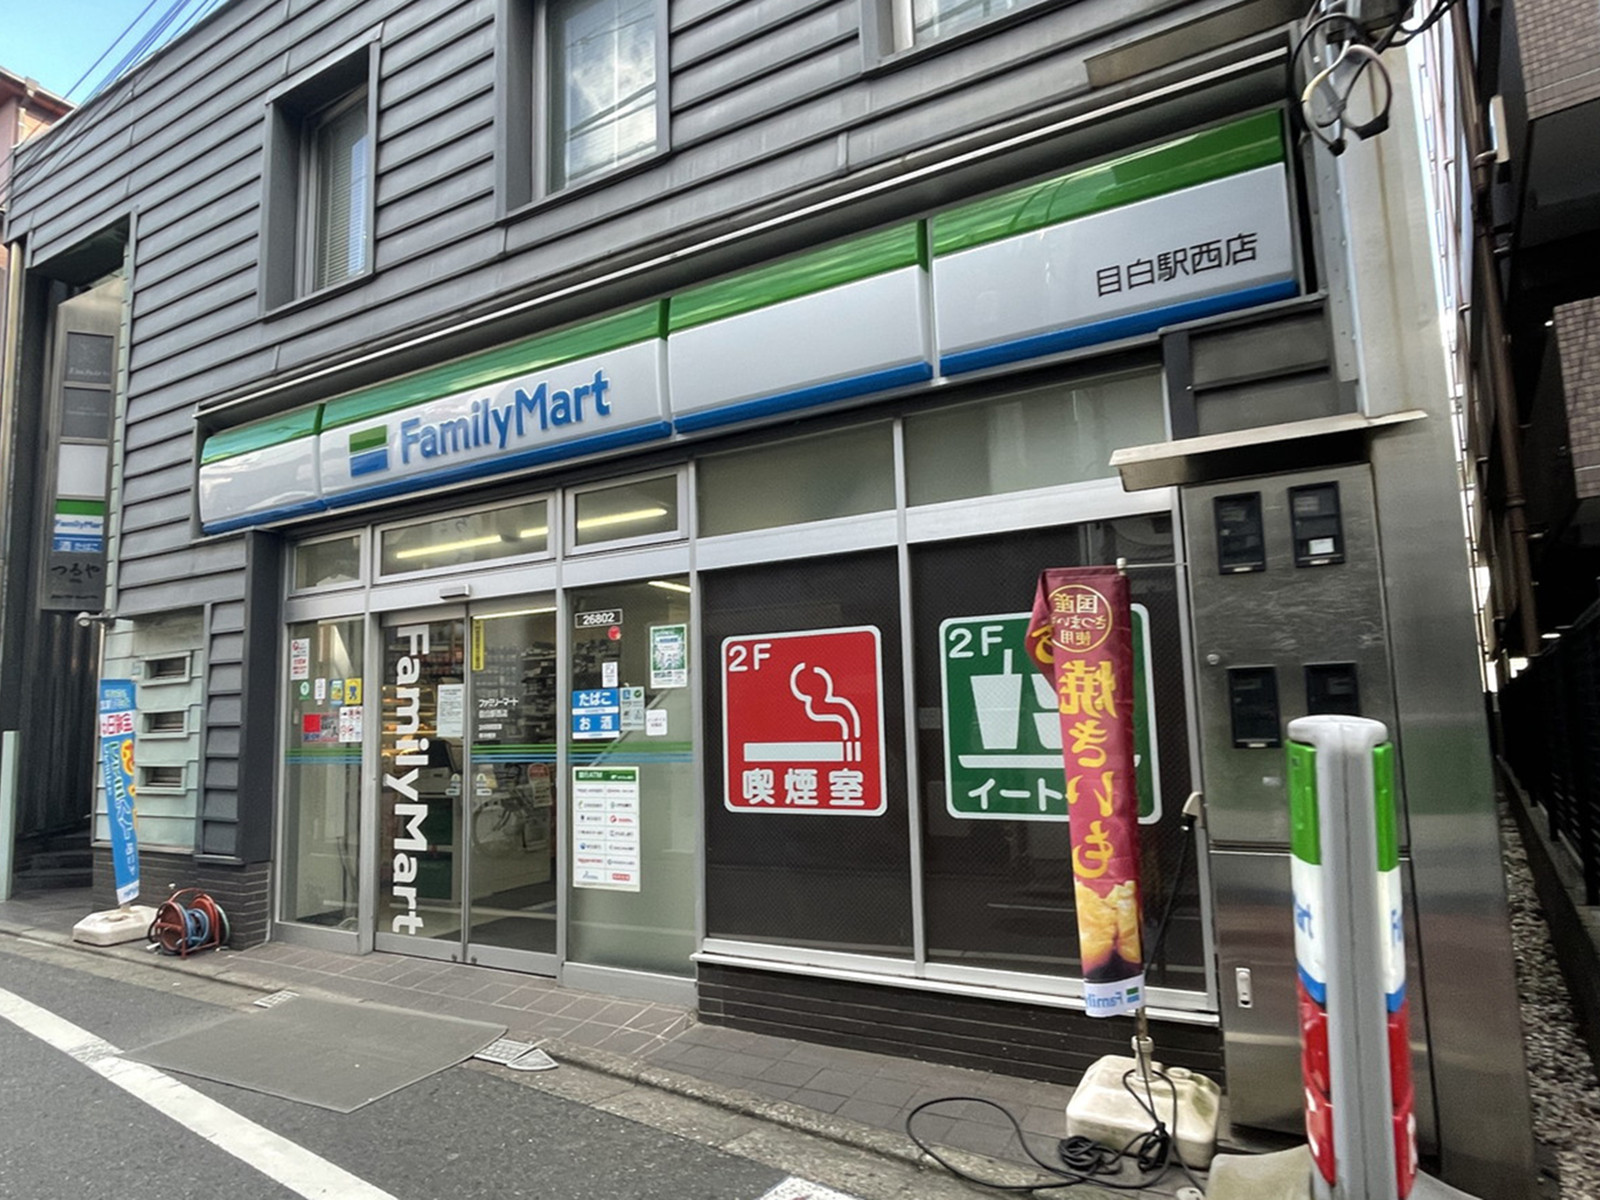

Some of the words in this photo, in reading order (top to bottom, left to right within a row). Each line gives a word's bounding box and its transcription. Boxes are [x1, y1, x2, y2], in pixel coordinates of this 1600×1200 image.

[1096, 232, 1258, 297] 目白駅西店
[401, 368, 611, 464] FamilyMart
[728, 643, 772, 672] 2F
[948, 625, 1004, 659] 2F
[578, 691, 612, 707] たばこ
[386, 624, 430, 935] FamilyMart
[742, 767, 865, 806] 喫煙室
[968, 778, 1065, 811] イート
